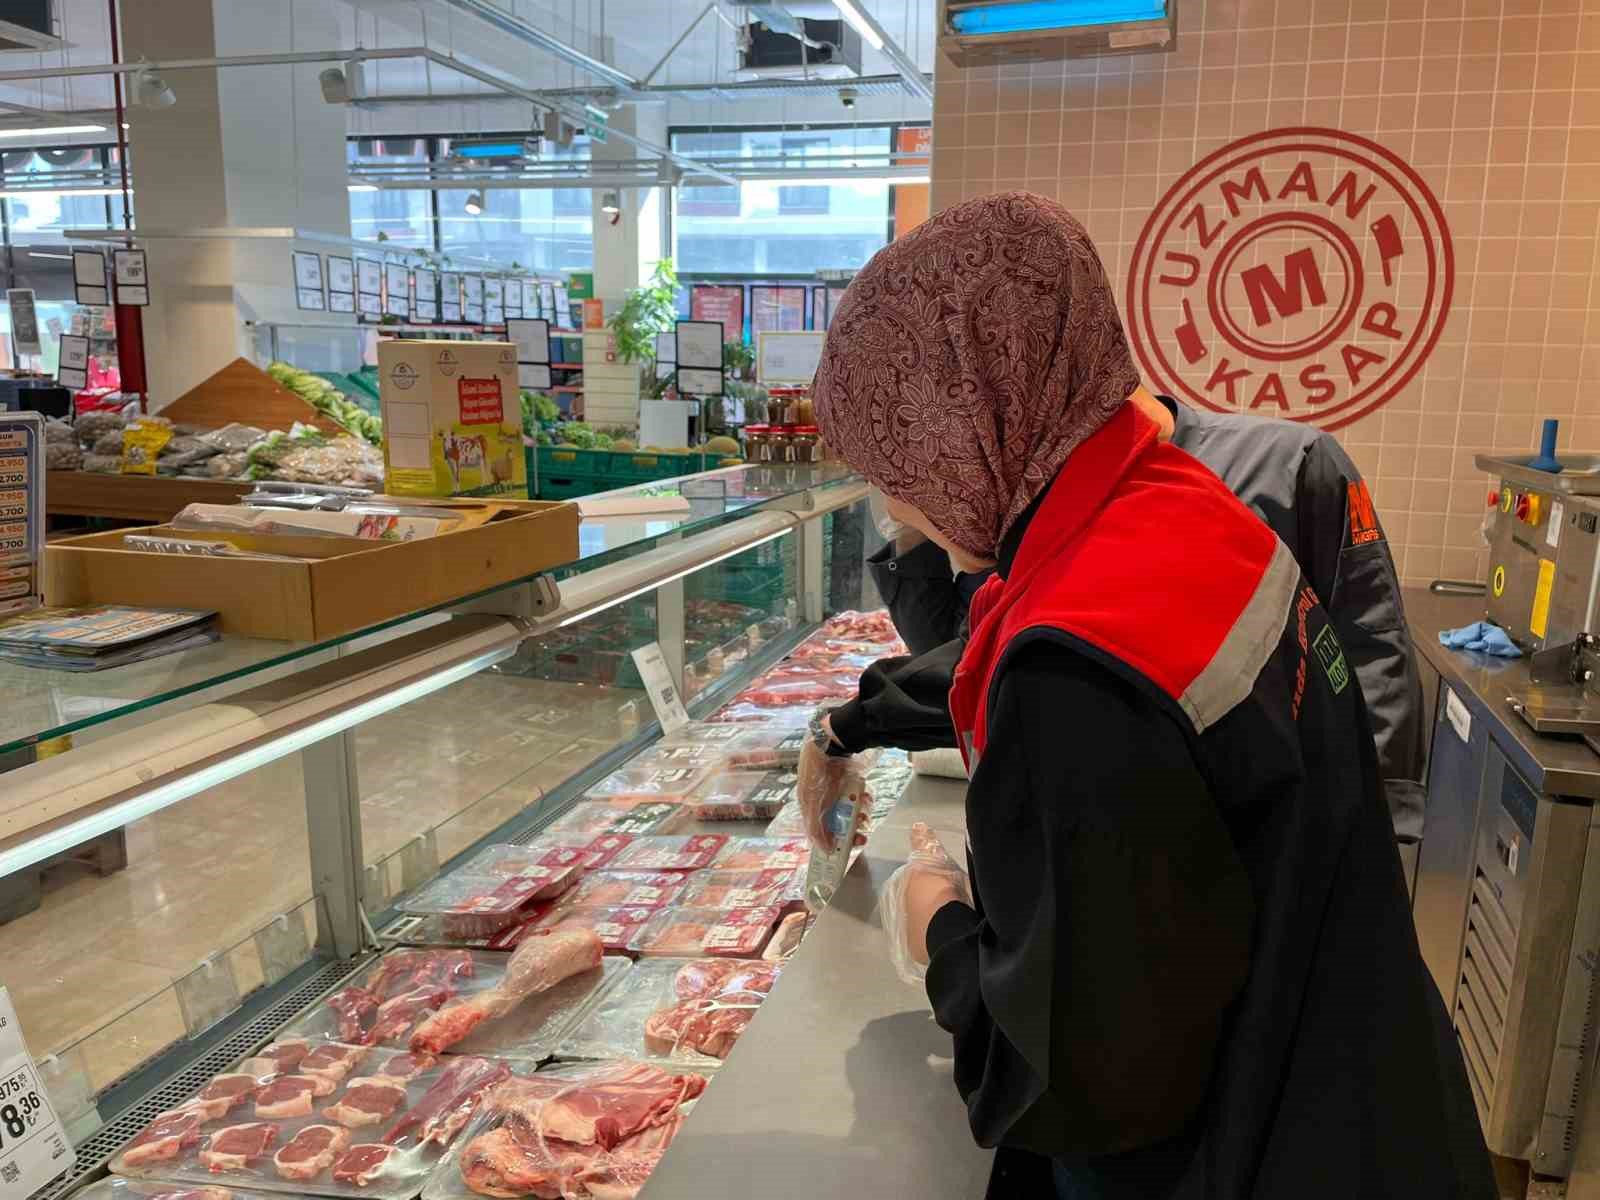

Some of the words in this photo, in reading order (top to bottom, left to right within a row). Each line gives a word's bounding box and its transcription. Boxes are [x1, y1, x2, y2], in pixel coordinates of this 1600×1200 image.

[1159, 161, 1377, 287] UZMAN
[1240, 248, 1327, 327] M
[1204, 302, 1404, 412] KASAP
